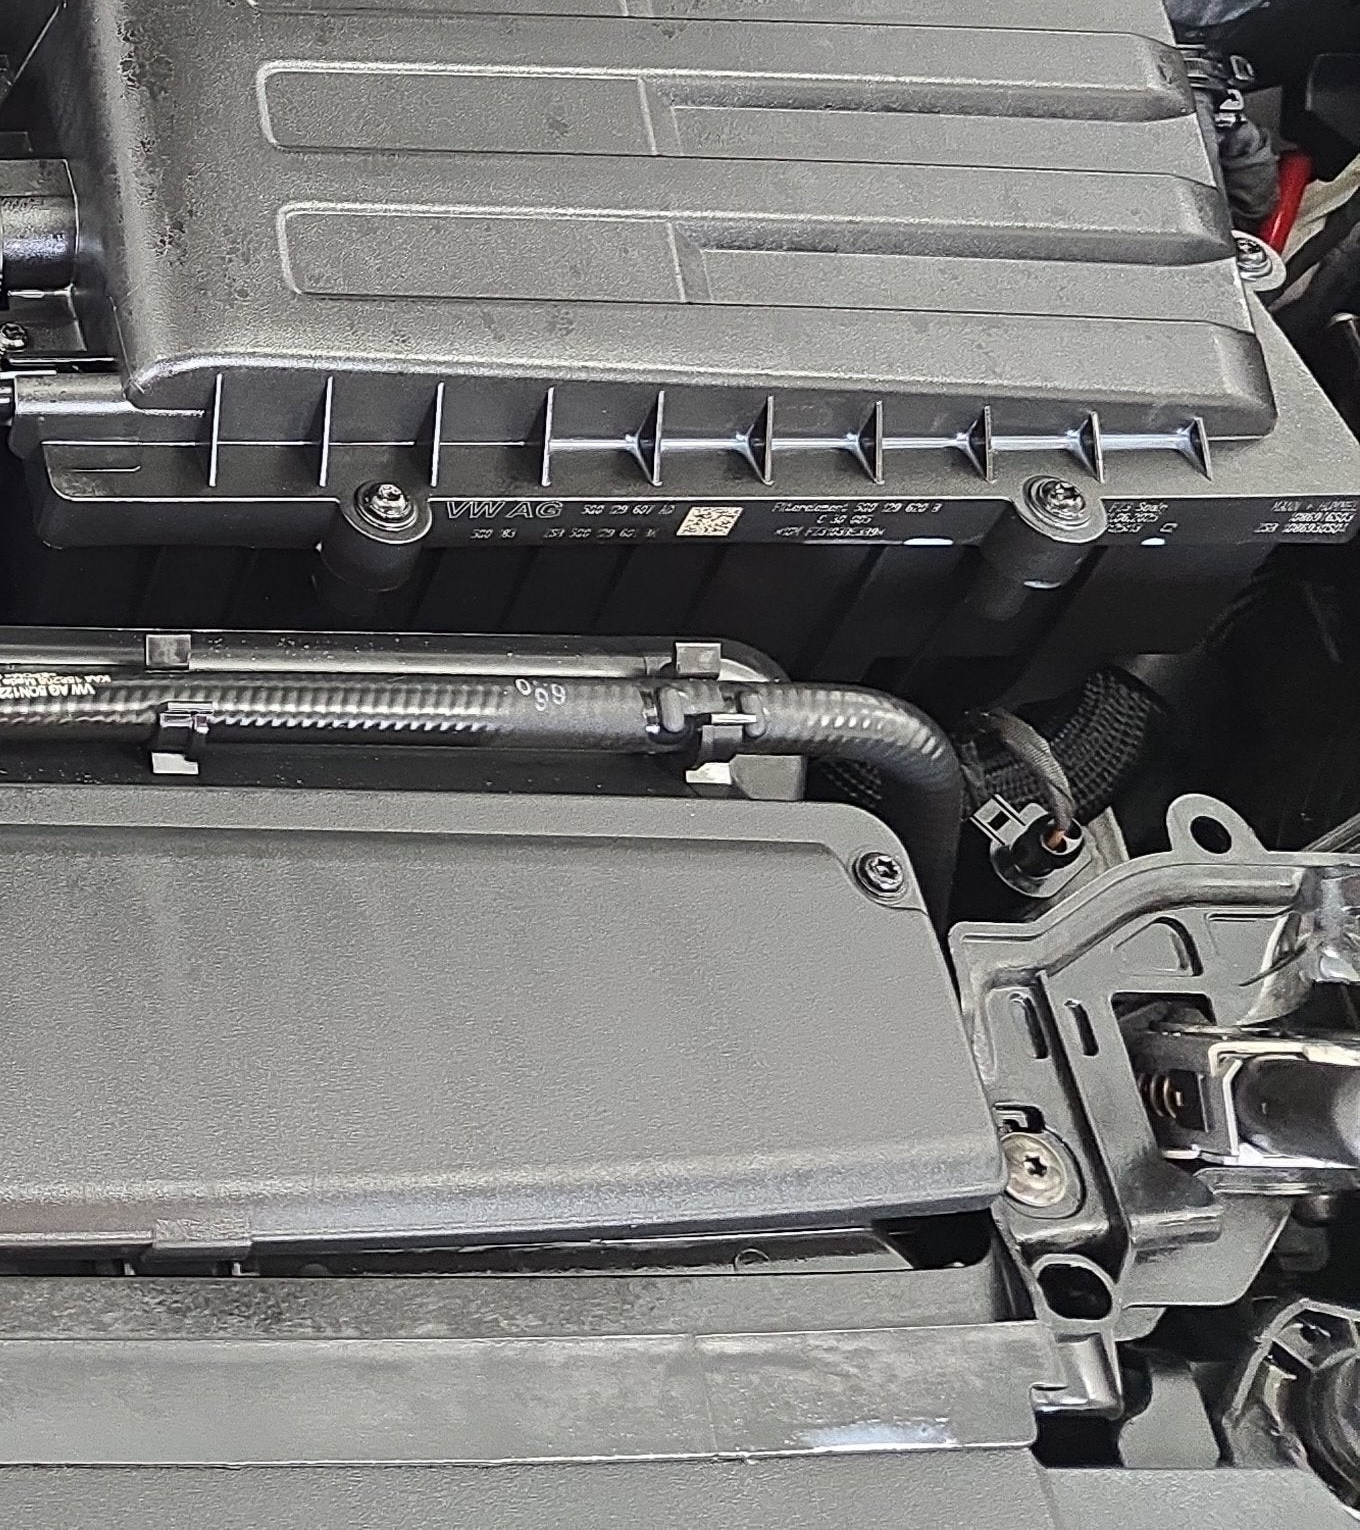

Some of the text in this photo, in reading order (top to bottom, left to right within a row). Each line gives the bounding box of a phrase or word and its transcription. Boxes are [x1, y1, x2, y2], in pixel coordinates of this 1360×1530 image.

[446, 501, 505, 519] VW
[505, 500, 564, 519] AG
[48, 684, 69, 696] AG
[71, 683, 96, 696] VW
